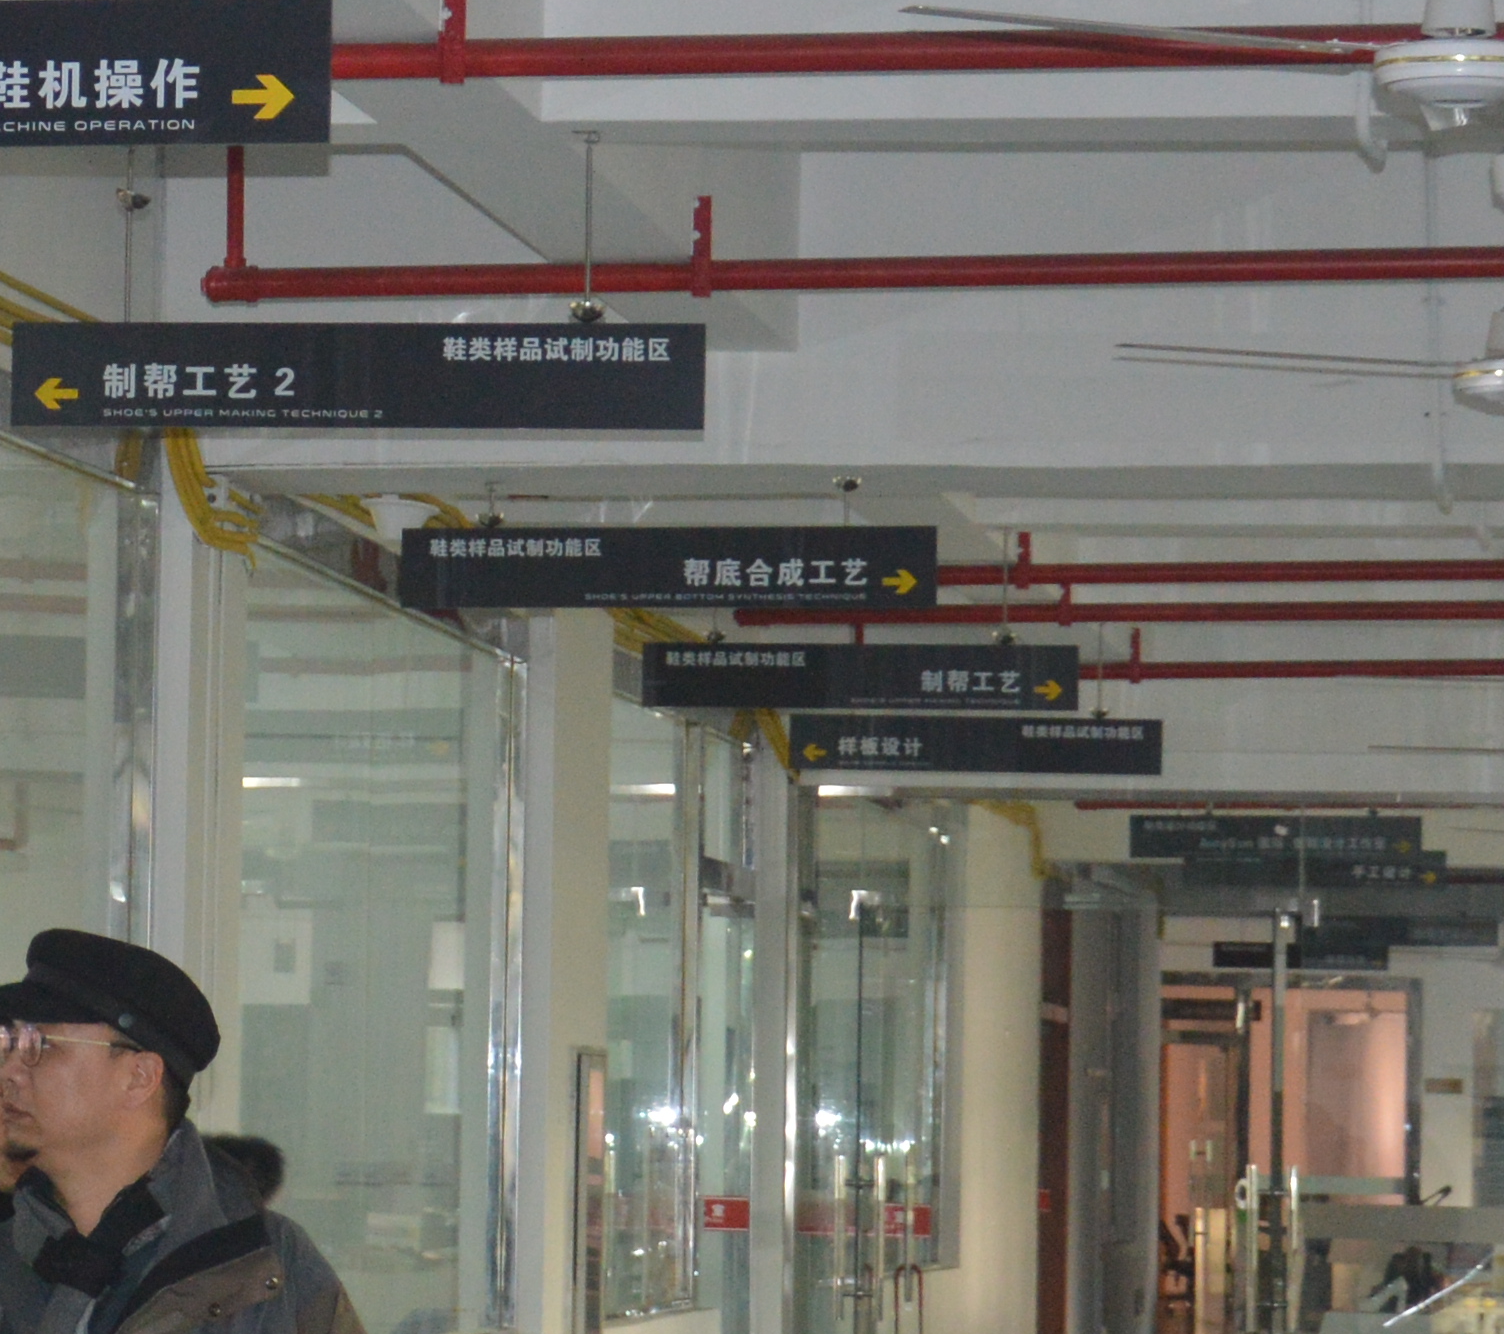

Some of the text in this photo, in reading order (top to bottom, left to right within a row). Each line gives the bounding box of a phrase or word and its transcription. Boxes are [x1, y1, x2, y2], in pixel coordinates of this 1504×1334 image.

[73, 118, 196, 132] OPERATION
[443, 336, 670, 362] 鞋类样品试制功能区
[102, 362, 295, 399] 制帮工艺 2
[102, 408, 158, 418] SHOE'S
[162, 408, 214, 418] UPPER
[218, 409, 276, 418] MAKING
[282, 409, 369, 419] TECHNIQUE
[430, 537, 601, 558] 鞋类样品试制功能区
[683, 558, 868, 588] 帮底合成工艺
[666, 651, 806, 667] 鞋类样品试制功能区
[921, 669, 1021, 694] 制帮工艺
[838, 736, 922, 757] 样板设计
